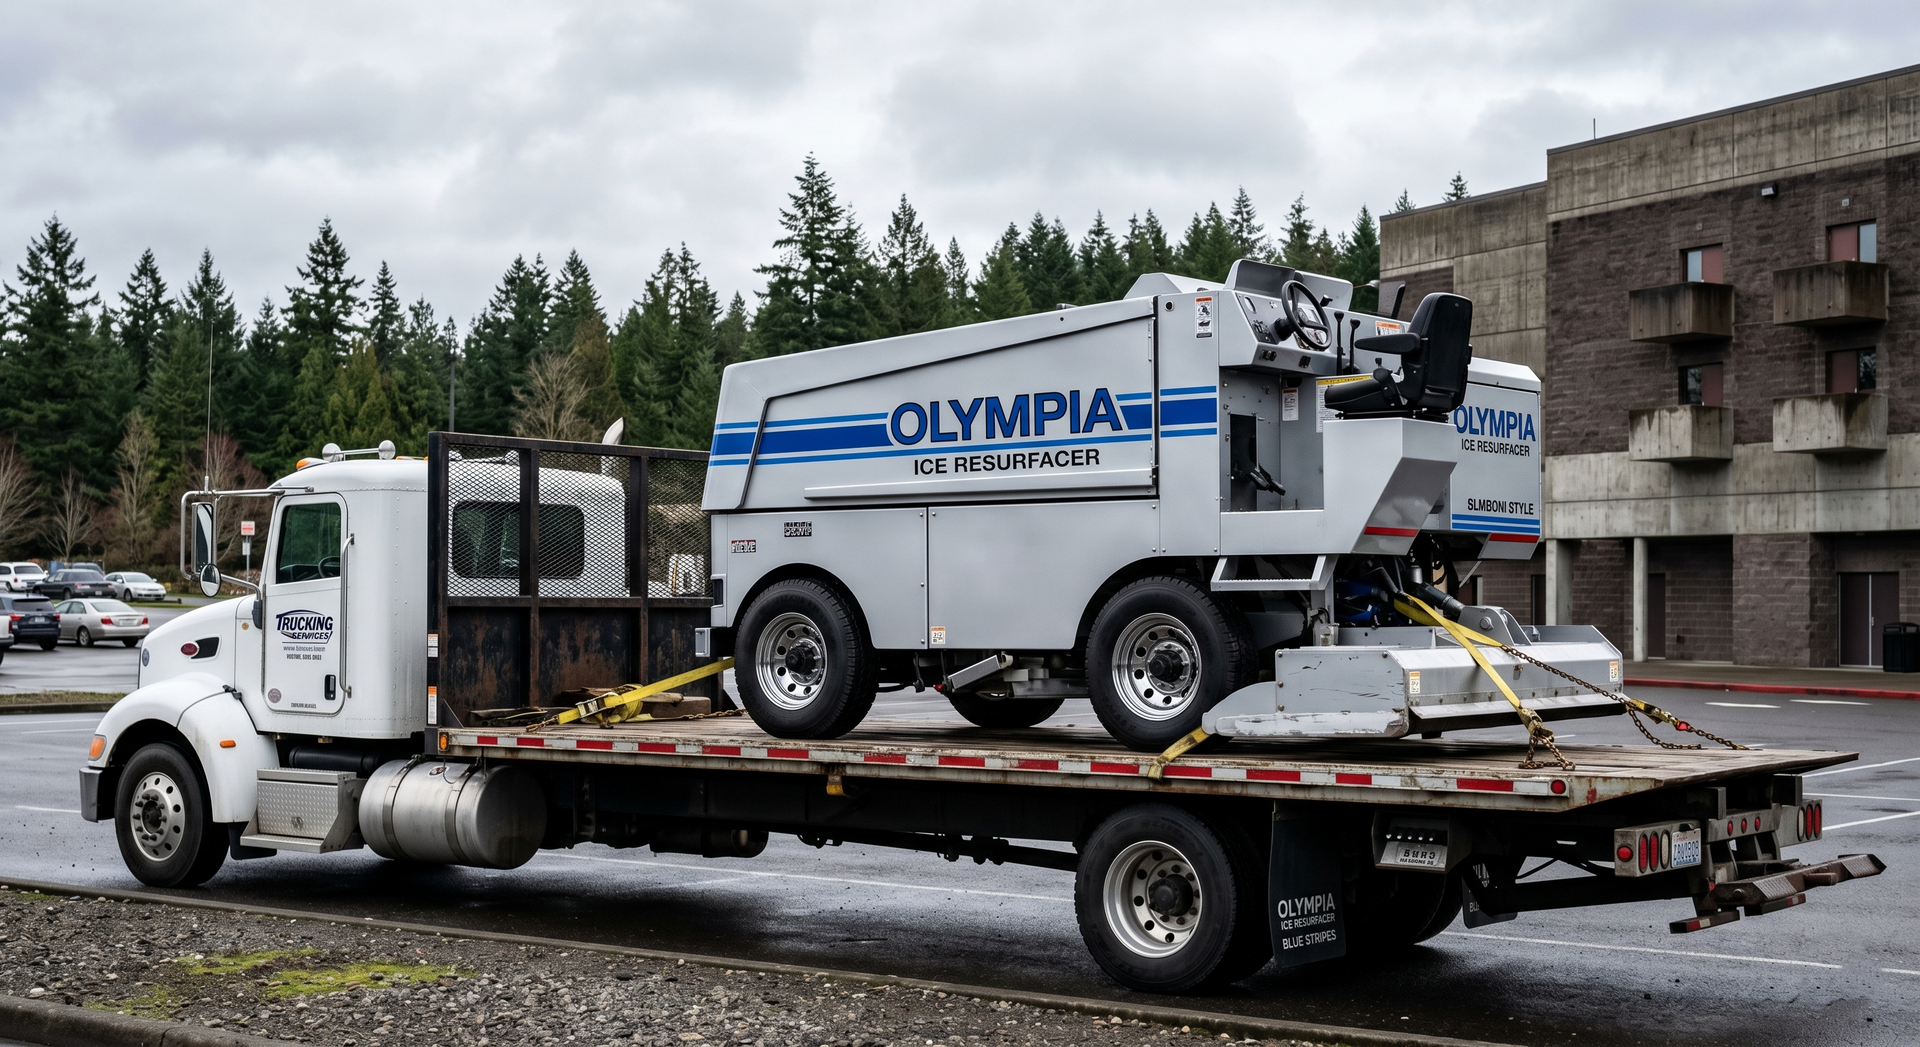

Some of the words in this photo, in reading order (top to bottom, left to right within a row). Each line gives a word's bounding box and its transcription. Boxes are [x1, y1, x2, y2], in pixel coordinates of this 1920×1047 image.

[890, 387, 1123, 446] OLYMPIA
[1453, 404, 1536, 442] OLYMPIA
[1461, 438, 1476, 451] ICE
[1477, 440, 1530, 457] RESURFACER
[914, 458, 948, 475] ICE
[954, 449, 1100, 473] RESURFACER
[1467, 498, 1507, 514] SLMBONI
[1508, 502, 1534, 515] STYLE
[275, 614, 334, 631] TRUCKING
[1277, 892, 1336, 918] OLYMPIA
[1280, 919, 1294, 930] ICE
[1294, 913, 1336, 928] RESURFACER
[1282, 935, 1305, 950] BLUE
[1305, 929, 1337, 945] STRIPES
